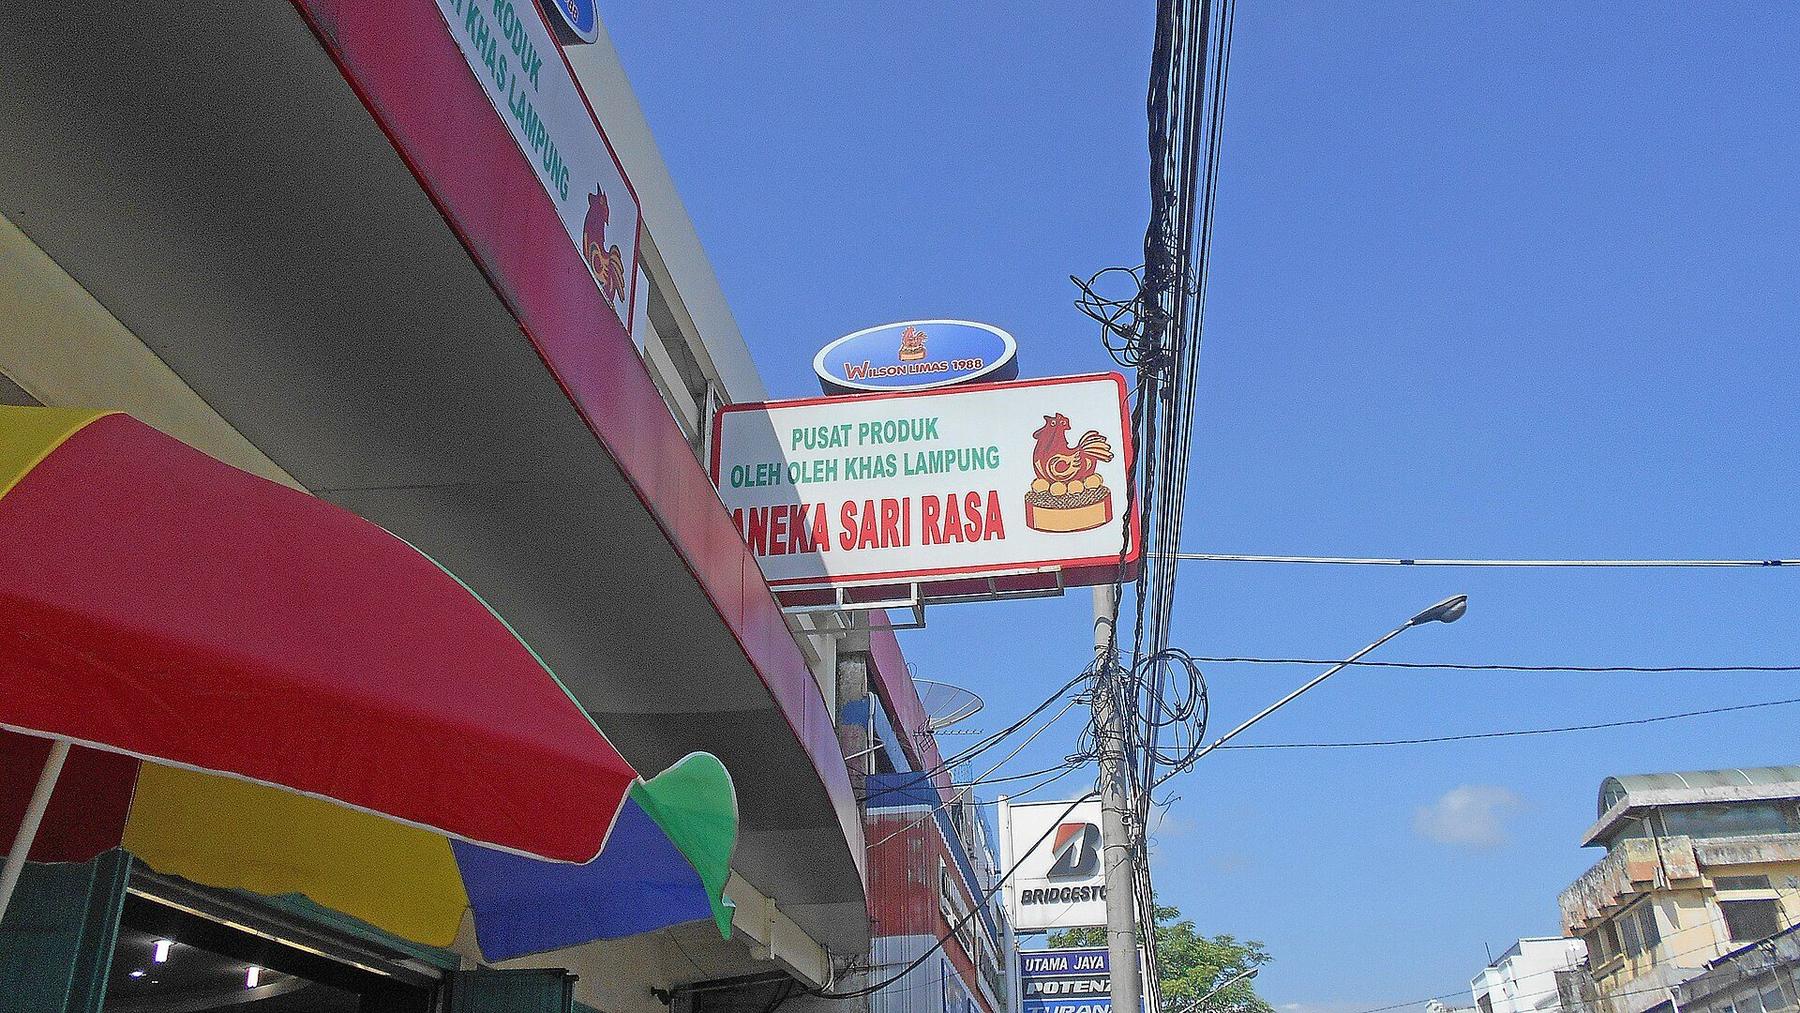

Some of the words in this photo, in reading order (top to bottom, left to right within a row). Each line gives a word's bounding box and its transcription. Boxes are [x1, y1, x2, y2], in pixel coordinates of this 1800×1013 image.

[508, 74, 569, 201] LAMPUNG
[909, 361, 949, 375] LIMAS
[952, 358, 984, 370] 1988
[792, 424, 853, 450] PUSAT
[858, 417, 939, 445] PRODUK
[730, 462, 782, 488] OLEH
[787, 458, 838, 485] OLEH
[844, 453, 898, 481] KHAS
[903, 445, 1000, 475] LAMPUNG
[839, 497, 911, 551] SARI
[921, 490, 1006, 545] RASA
[1025, 957, 1068, 972] UTAMA
[1073, 955, 1105, 970] JAYA
[1027, 1004, 1112, 1013] TURAN
